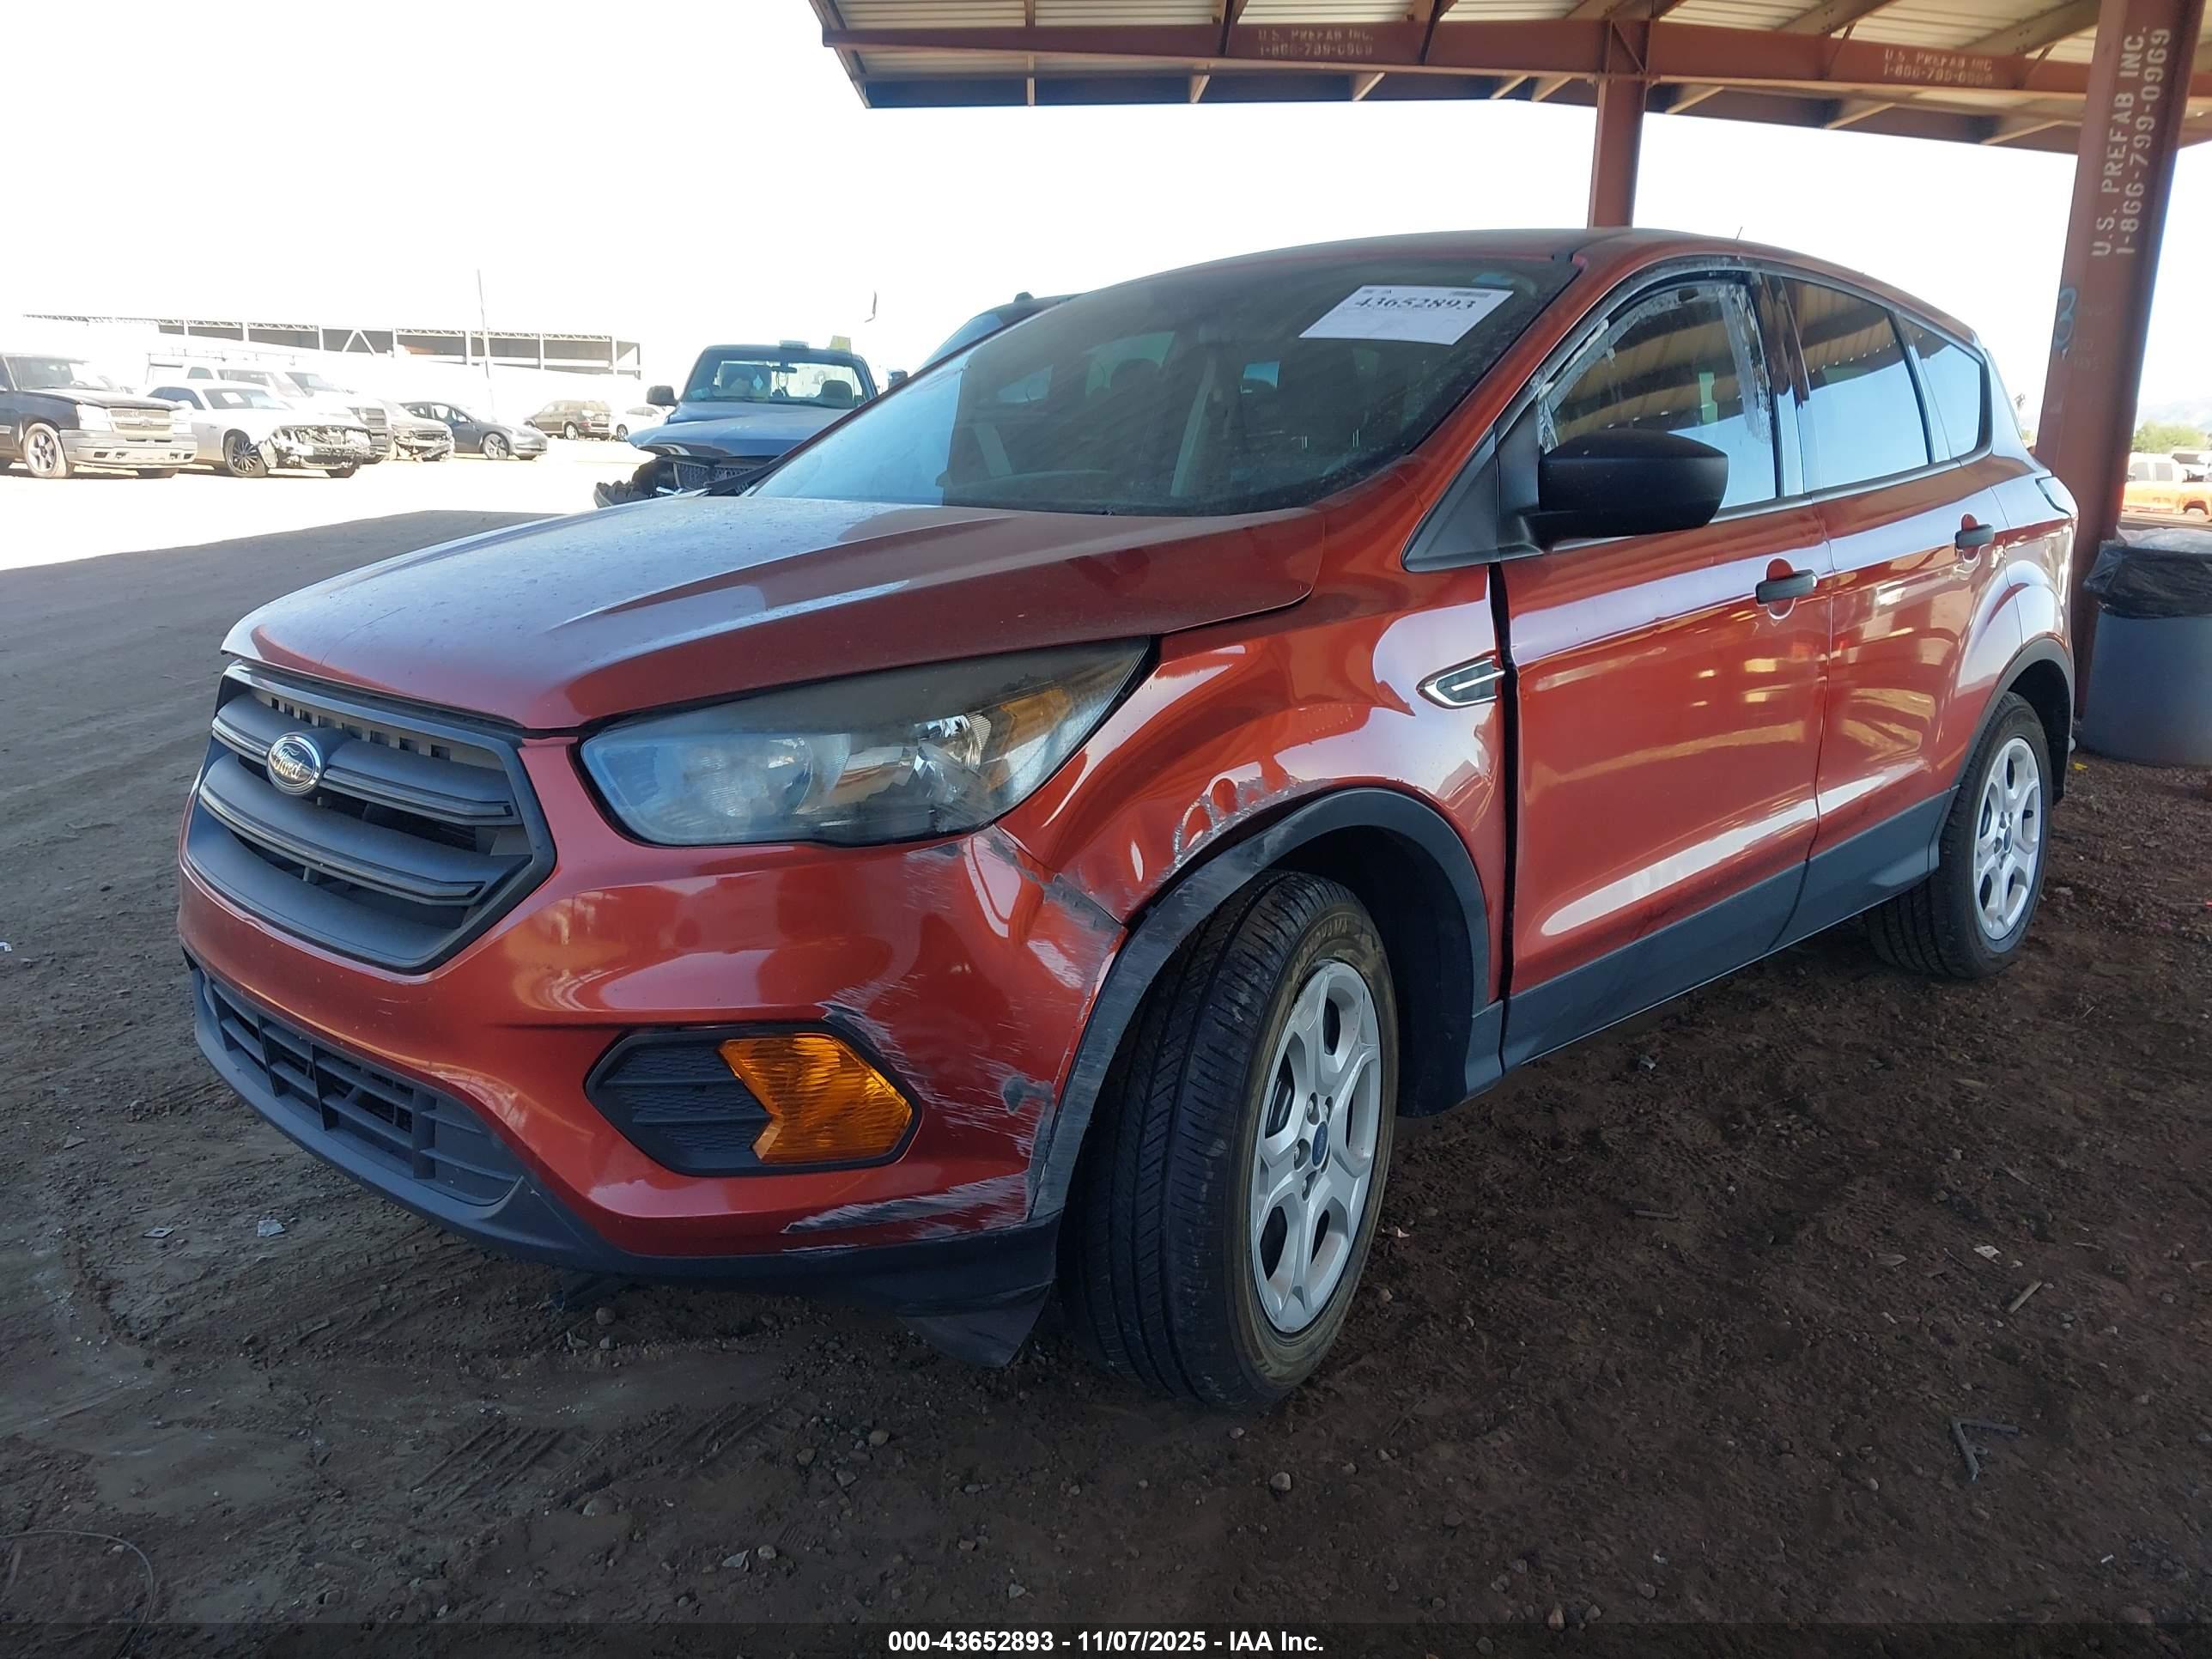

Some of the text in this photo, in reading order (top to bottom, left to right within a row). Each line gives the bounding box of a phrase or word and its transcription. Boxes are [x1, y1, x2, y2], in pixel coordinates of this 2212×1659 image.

[2091, 26, 2148, 258] U.S. PREFAB INC.
[2115, 28, 2172, 256] 1-866-799-0969
[1354, 296, 1477, 311] 43652893
